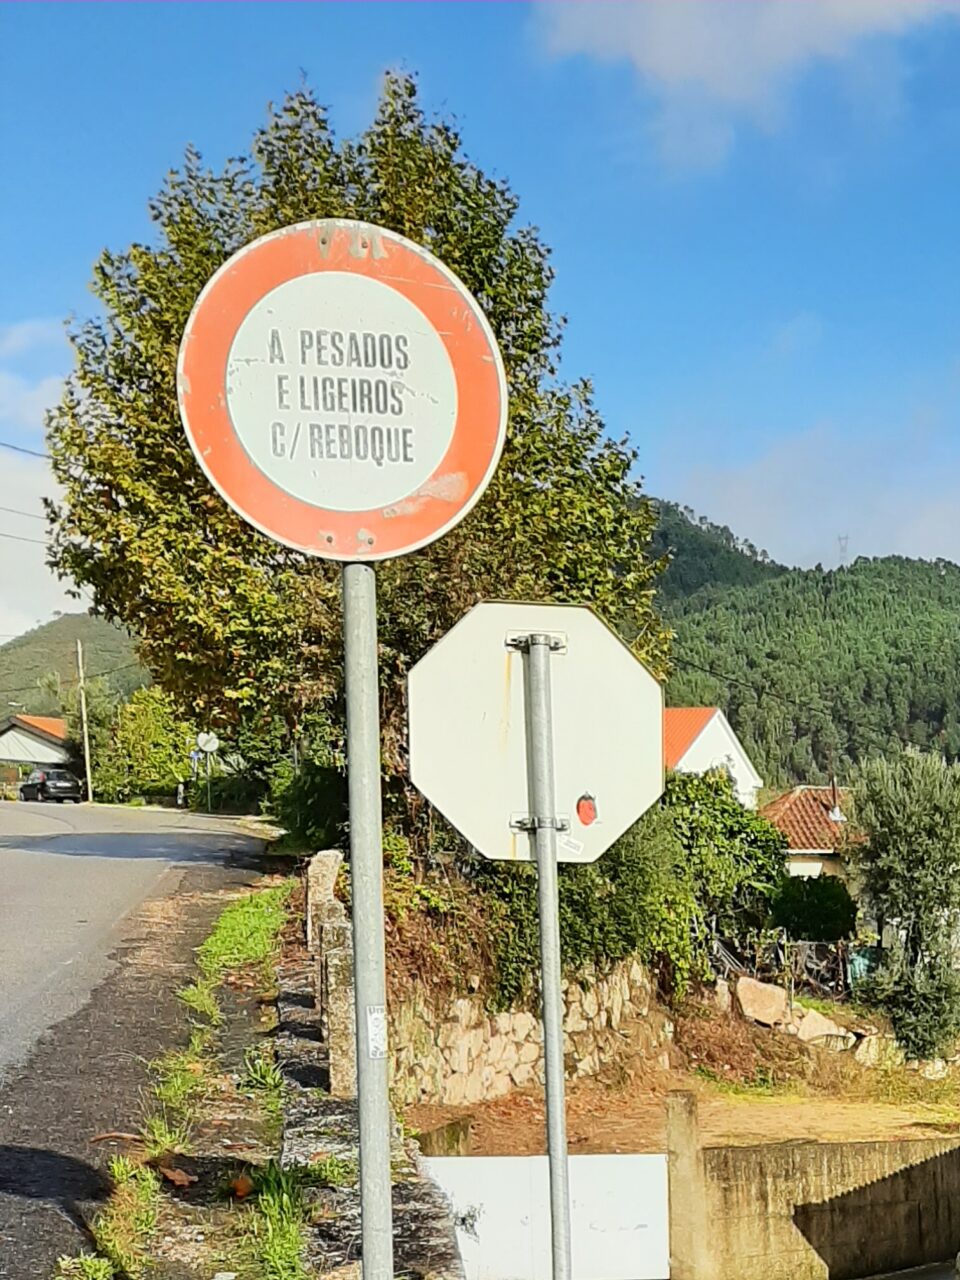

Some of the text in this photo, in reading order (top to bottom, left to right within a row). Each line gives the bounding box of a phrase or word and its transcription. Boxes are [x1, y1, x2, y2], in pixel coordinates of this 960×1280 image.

[269, 329, 409, 370] A PESADOS
[277, 374, 404, 416] E LIGEIROS
[309, 423, 414, 467] REBOQUE
